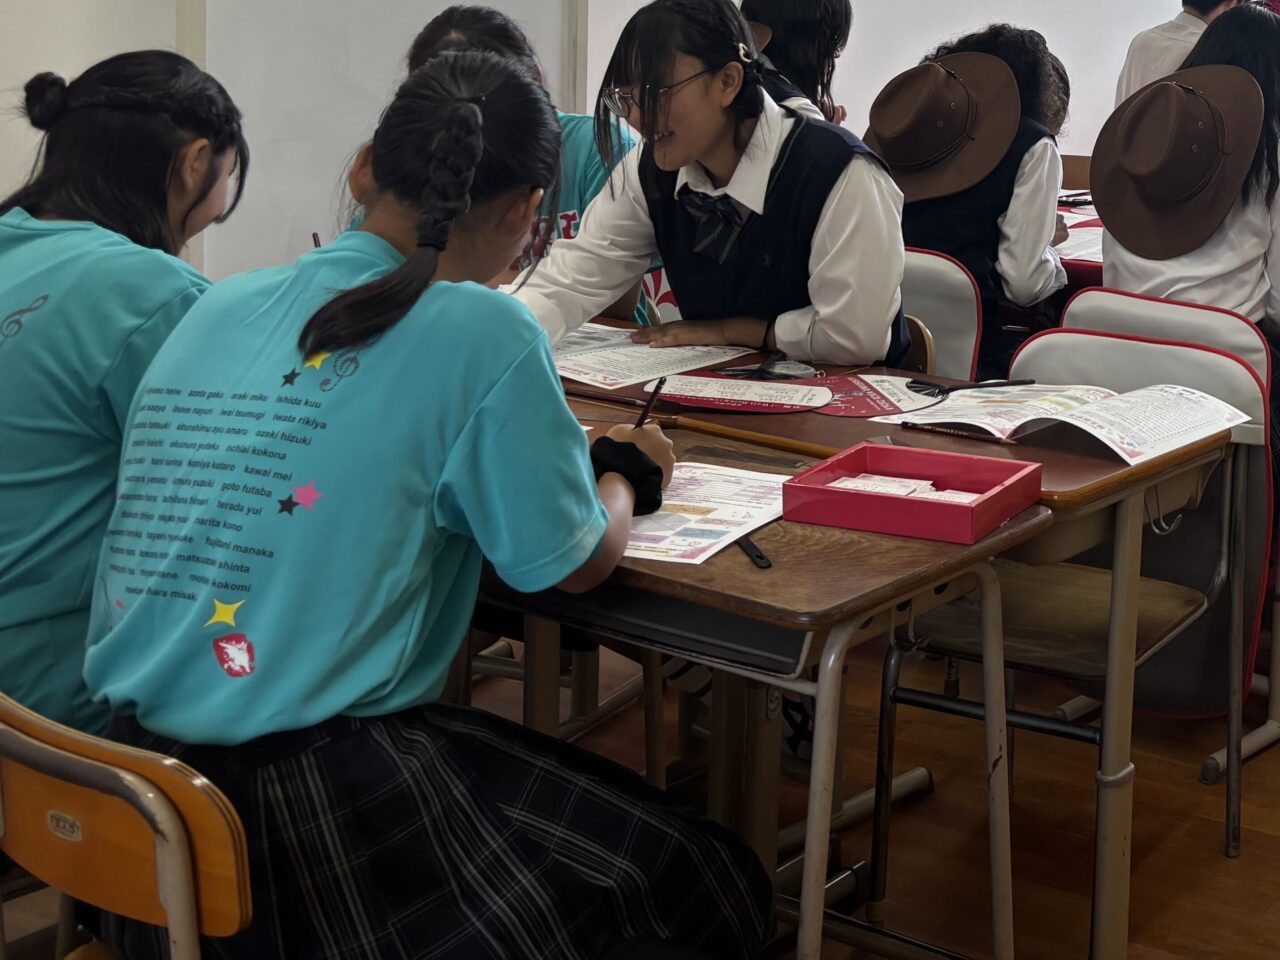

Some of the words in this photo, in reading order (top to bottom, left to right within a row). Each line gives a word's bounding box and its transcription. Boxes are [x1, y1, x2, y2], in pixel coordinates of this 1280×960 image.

[275, 394, 302, 405] ishida
[304, 398, 322, 409] kuu
[272, 411, 297, 422] iwata
[298, 416, 327, 429] rikiya
[280, 432, 312, 446] hizuki
[251, 446, 287, 460] kokona
[244, 464, 272, 477] kawai
[272, 471, 293, 481] mei
[220, 482, 241, 492] goto
[242, 484, 272, 497] futaba
[217, 500, 246, 512] terada
[245, 506, 263, 516] yui
[194, 517, 221, 528] narita
[232, 544, 274, 558] manaka
[217, 560, 250, 573] shinta
[211, 578, 252, 593] kokomi
